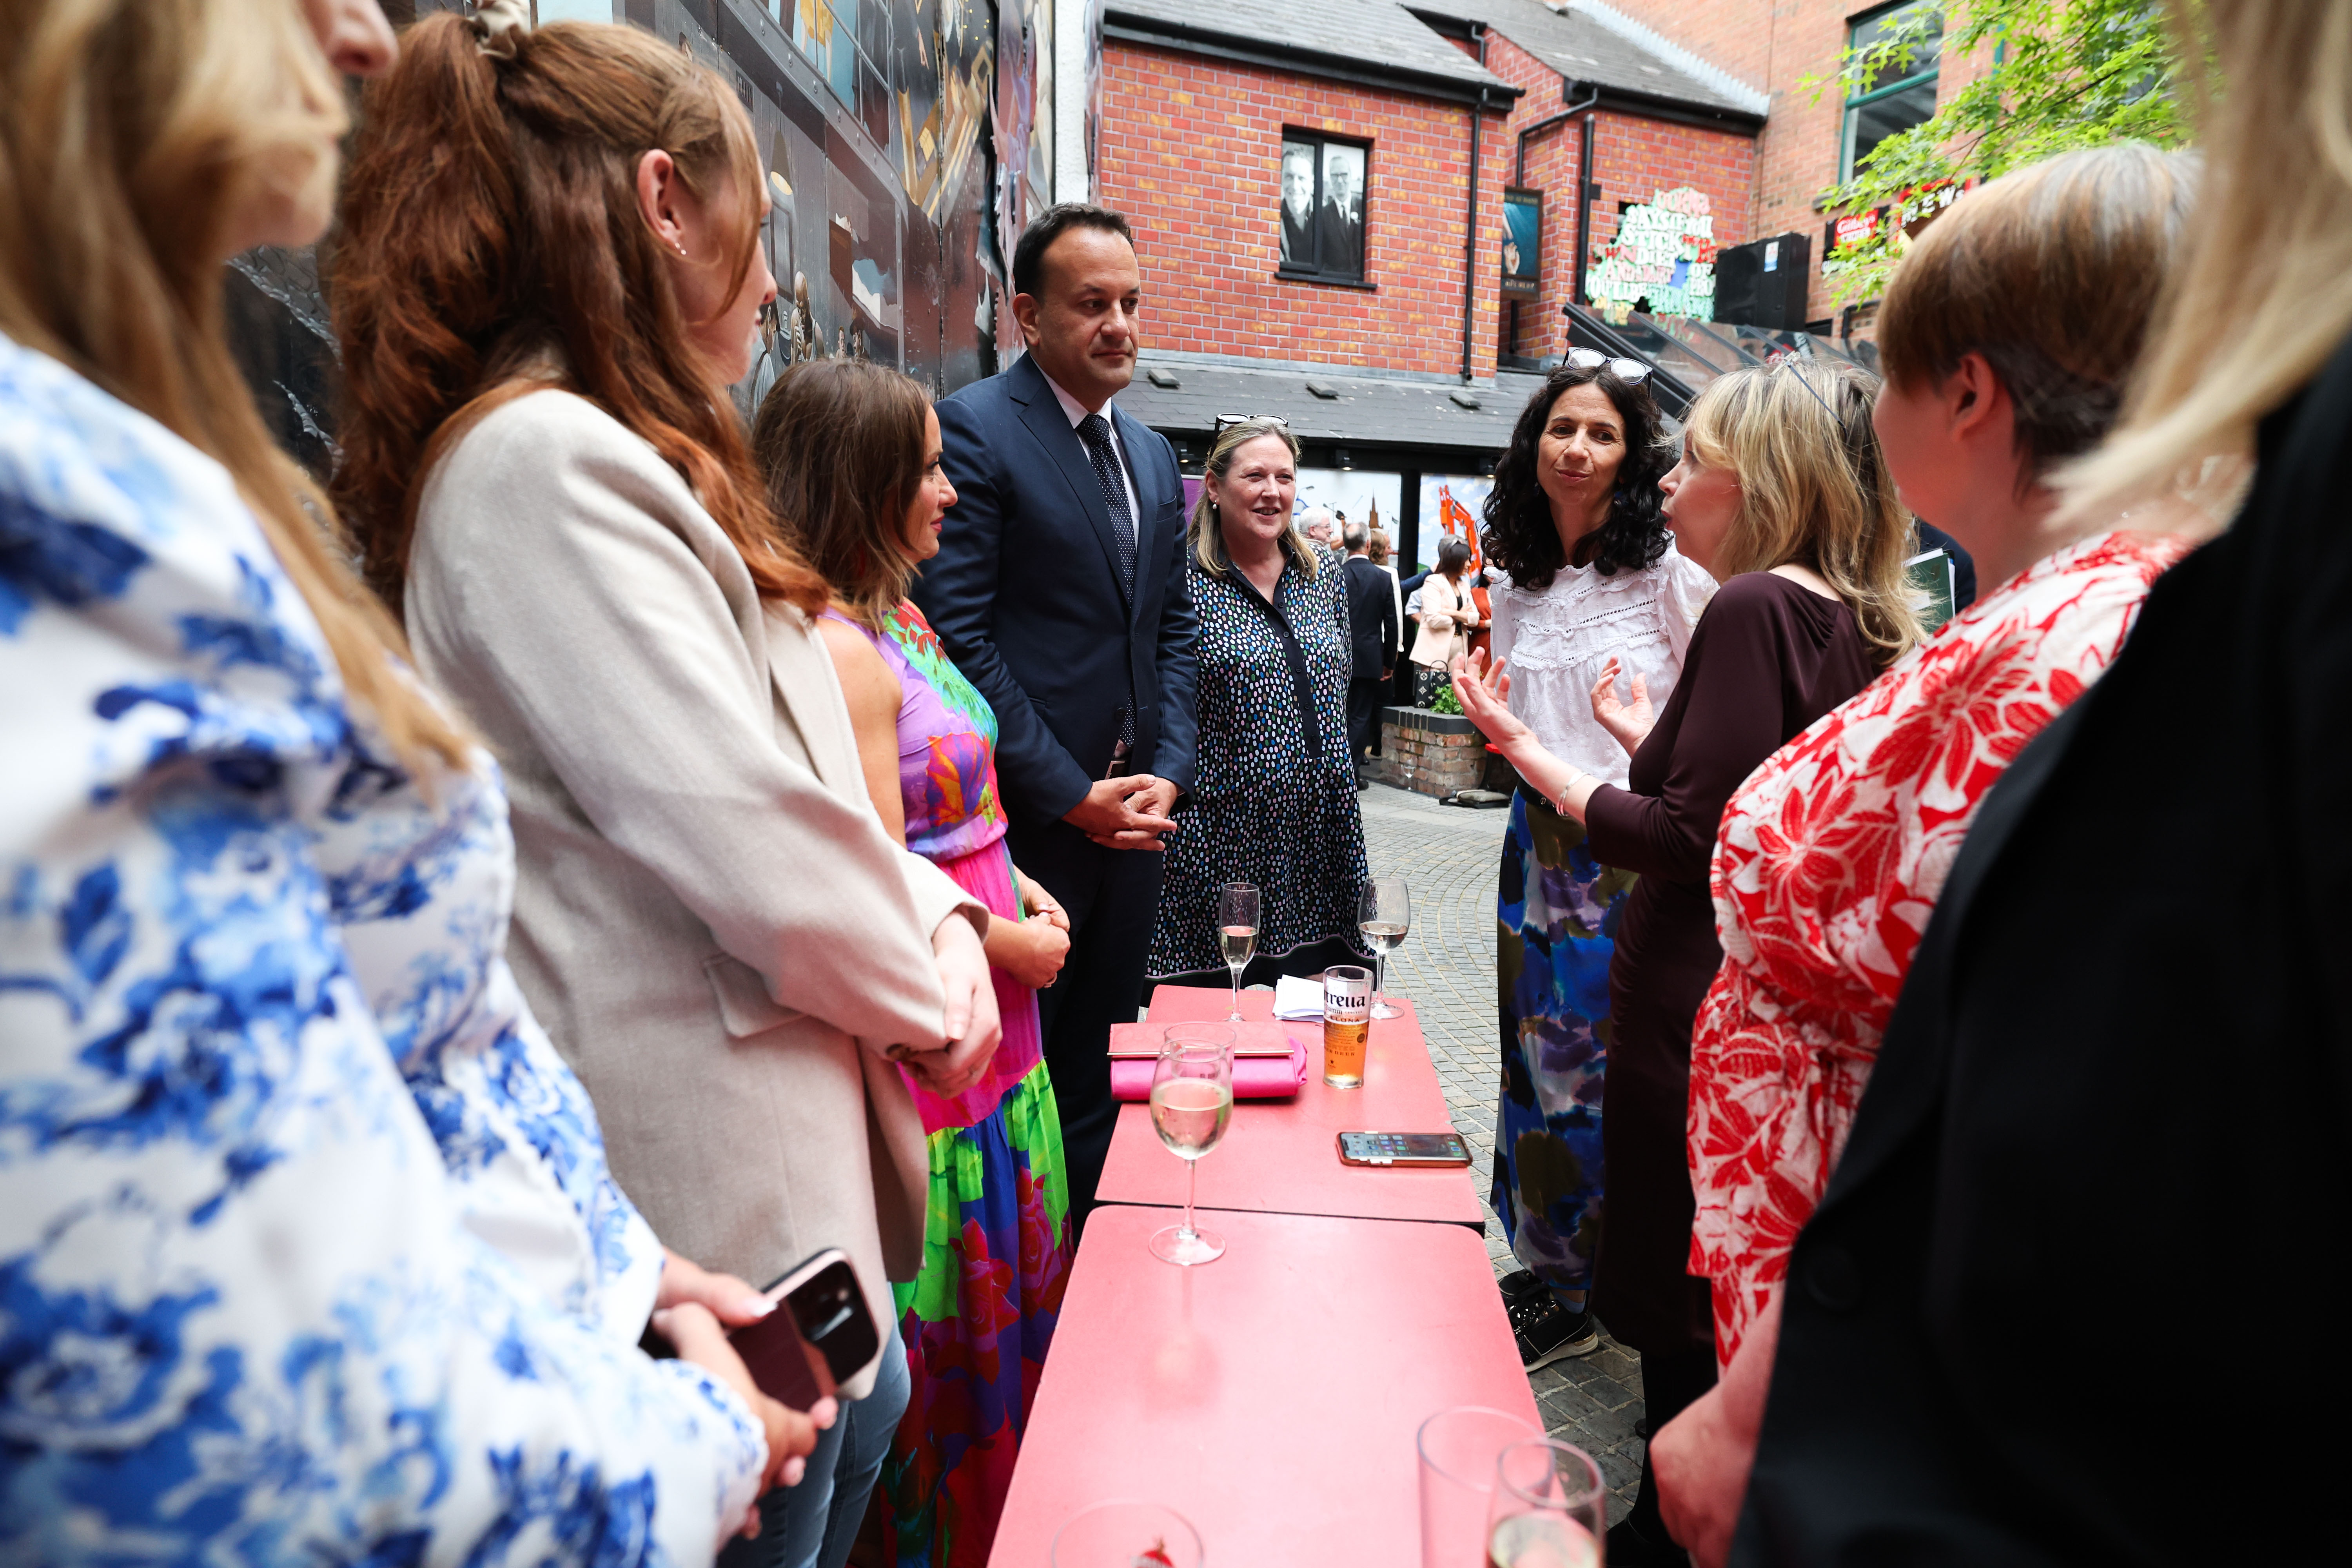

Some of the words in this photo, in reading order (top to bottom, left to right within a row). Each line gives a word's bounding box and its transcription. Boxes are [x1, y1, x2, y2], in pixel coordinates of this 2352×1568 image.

[1622, 223, 1686, 255] STICK
[1635, 246, 1679, 269] DIET
[1691, 263, 1713, 278] OF
[1324, 990, 1365, 1007] trella
[1326, 1004, 1343, 1014] Damm
